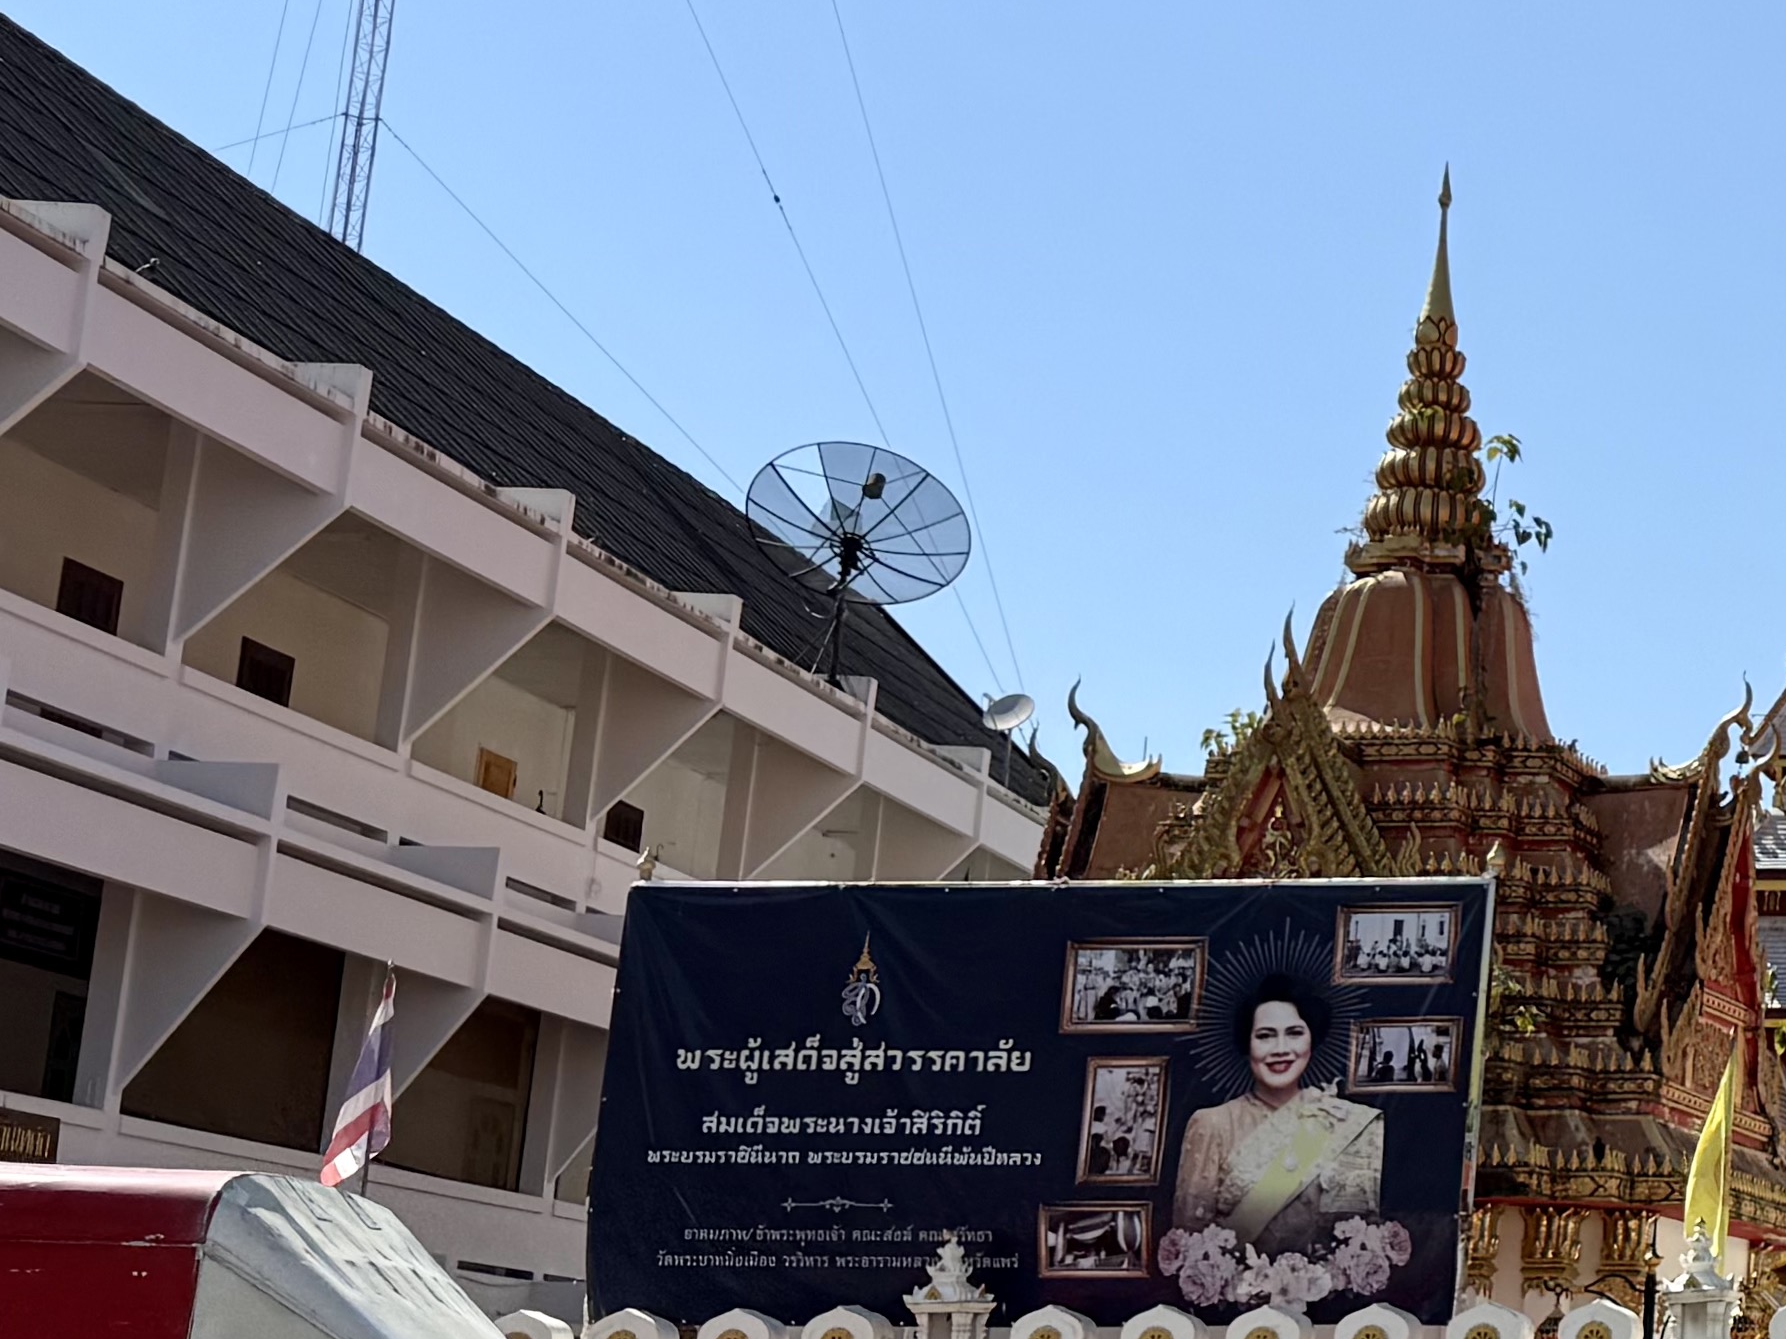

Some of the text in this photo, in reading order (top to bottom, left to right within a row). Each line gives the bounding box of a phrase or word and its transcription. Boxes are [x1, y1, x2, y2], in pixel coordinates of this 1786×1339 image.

[675, 1034, 1033, 1085] พระผู้เสด็จสู่สวรรคาลัย
[701, 1104, 986, 1136] สมเด็จพระนางเจ้าสิริกิติ์
[646, 1144, 1042, 1167] พระบรมราชินีนาถ พระบรมราชชนนีพันปีหลวง
